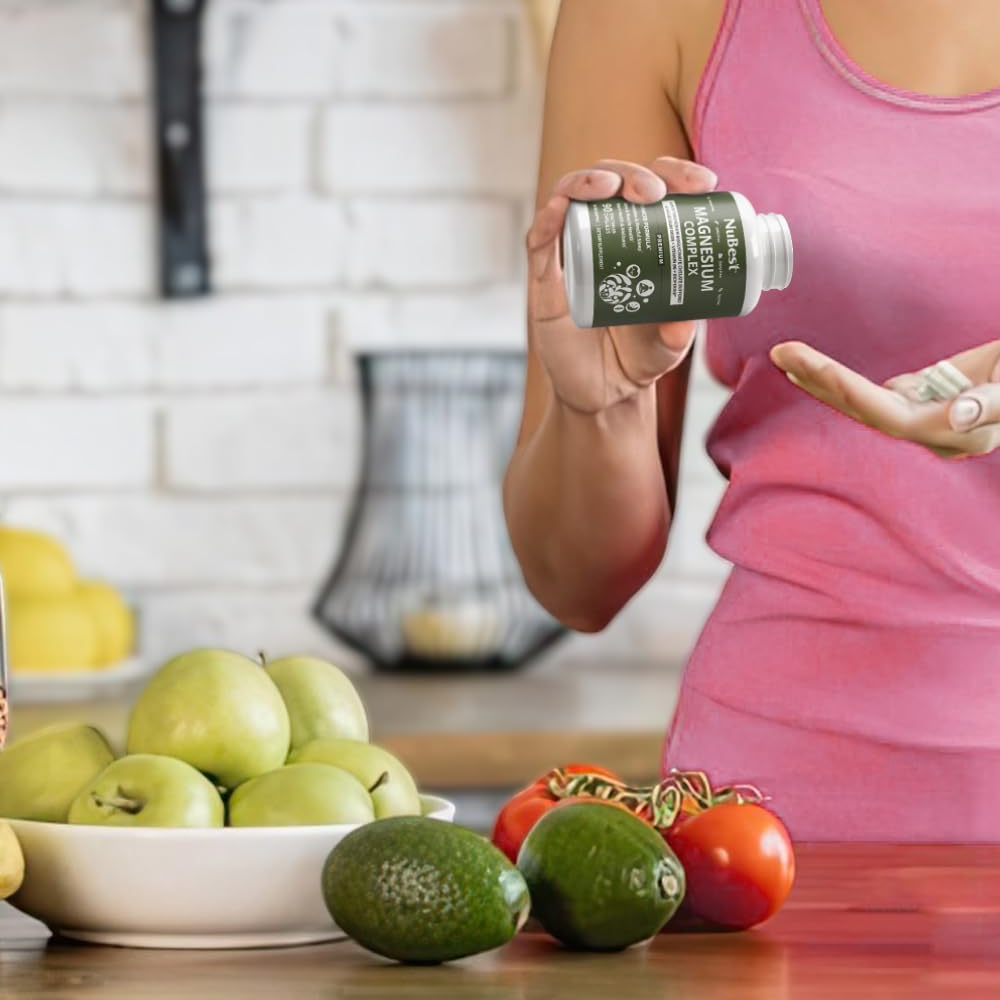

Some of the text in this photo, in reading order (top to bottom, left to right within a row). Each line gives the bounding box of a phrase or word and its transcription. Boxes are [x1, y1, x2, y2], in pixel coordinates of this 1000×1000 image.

[684, 221, 698, 276] COMPLEX
[694, 206, 714, 292] MAGNESIUM
[723, 218, 739, 271] NuBest
